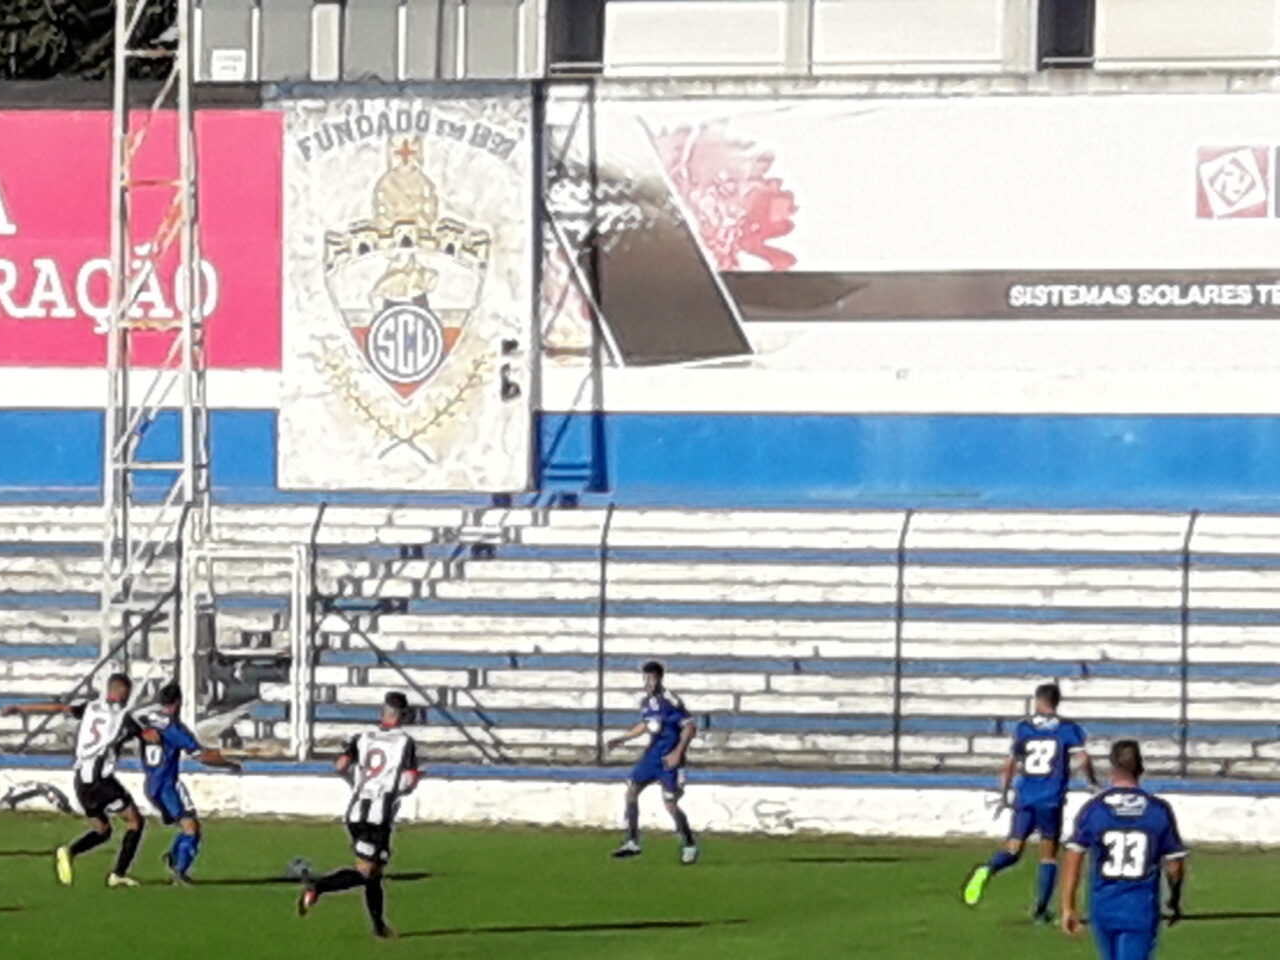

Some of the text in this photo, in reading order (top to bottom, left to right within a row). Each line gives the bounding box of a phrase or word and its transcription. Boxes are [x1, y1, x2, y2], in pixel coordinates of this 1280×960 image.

[297, 108, 431, 162] FUNDADO
[1009, 283, 1132, 307] SISTEMAS
[1137, 283, 1254, 306] SOLARES
[83, 717, 106, 749] 5
[1102, 831, 1147, 877] 33
